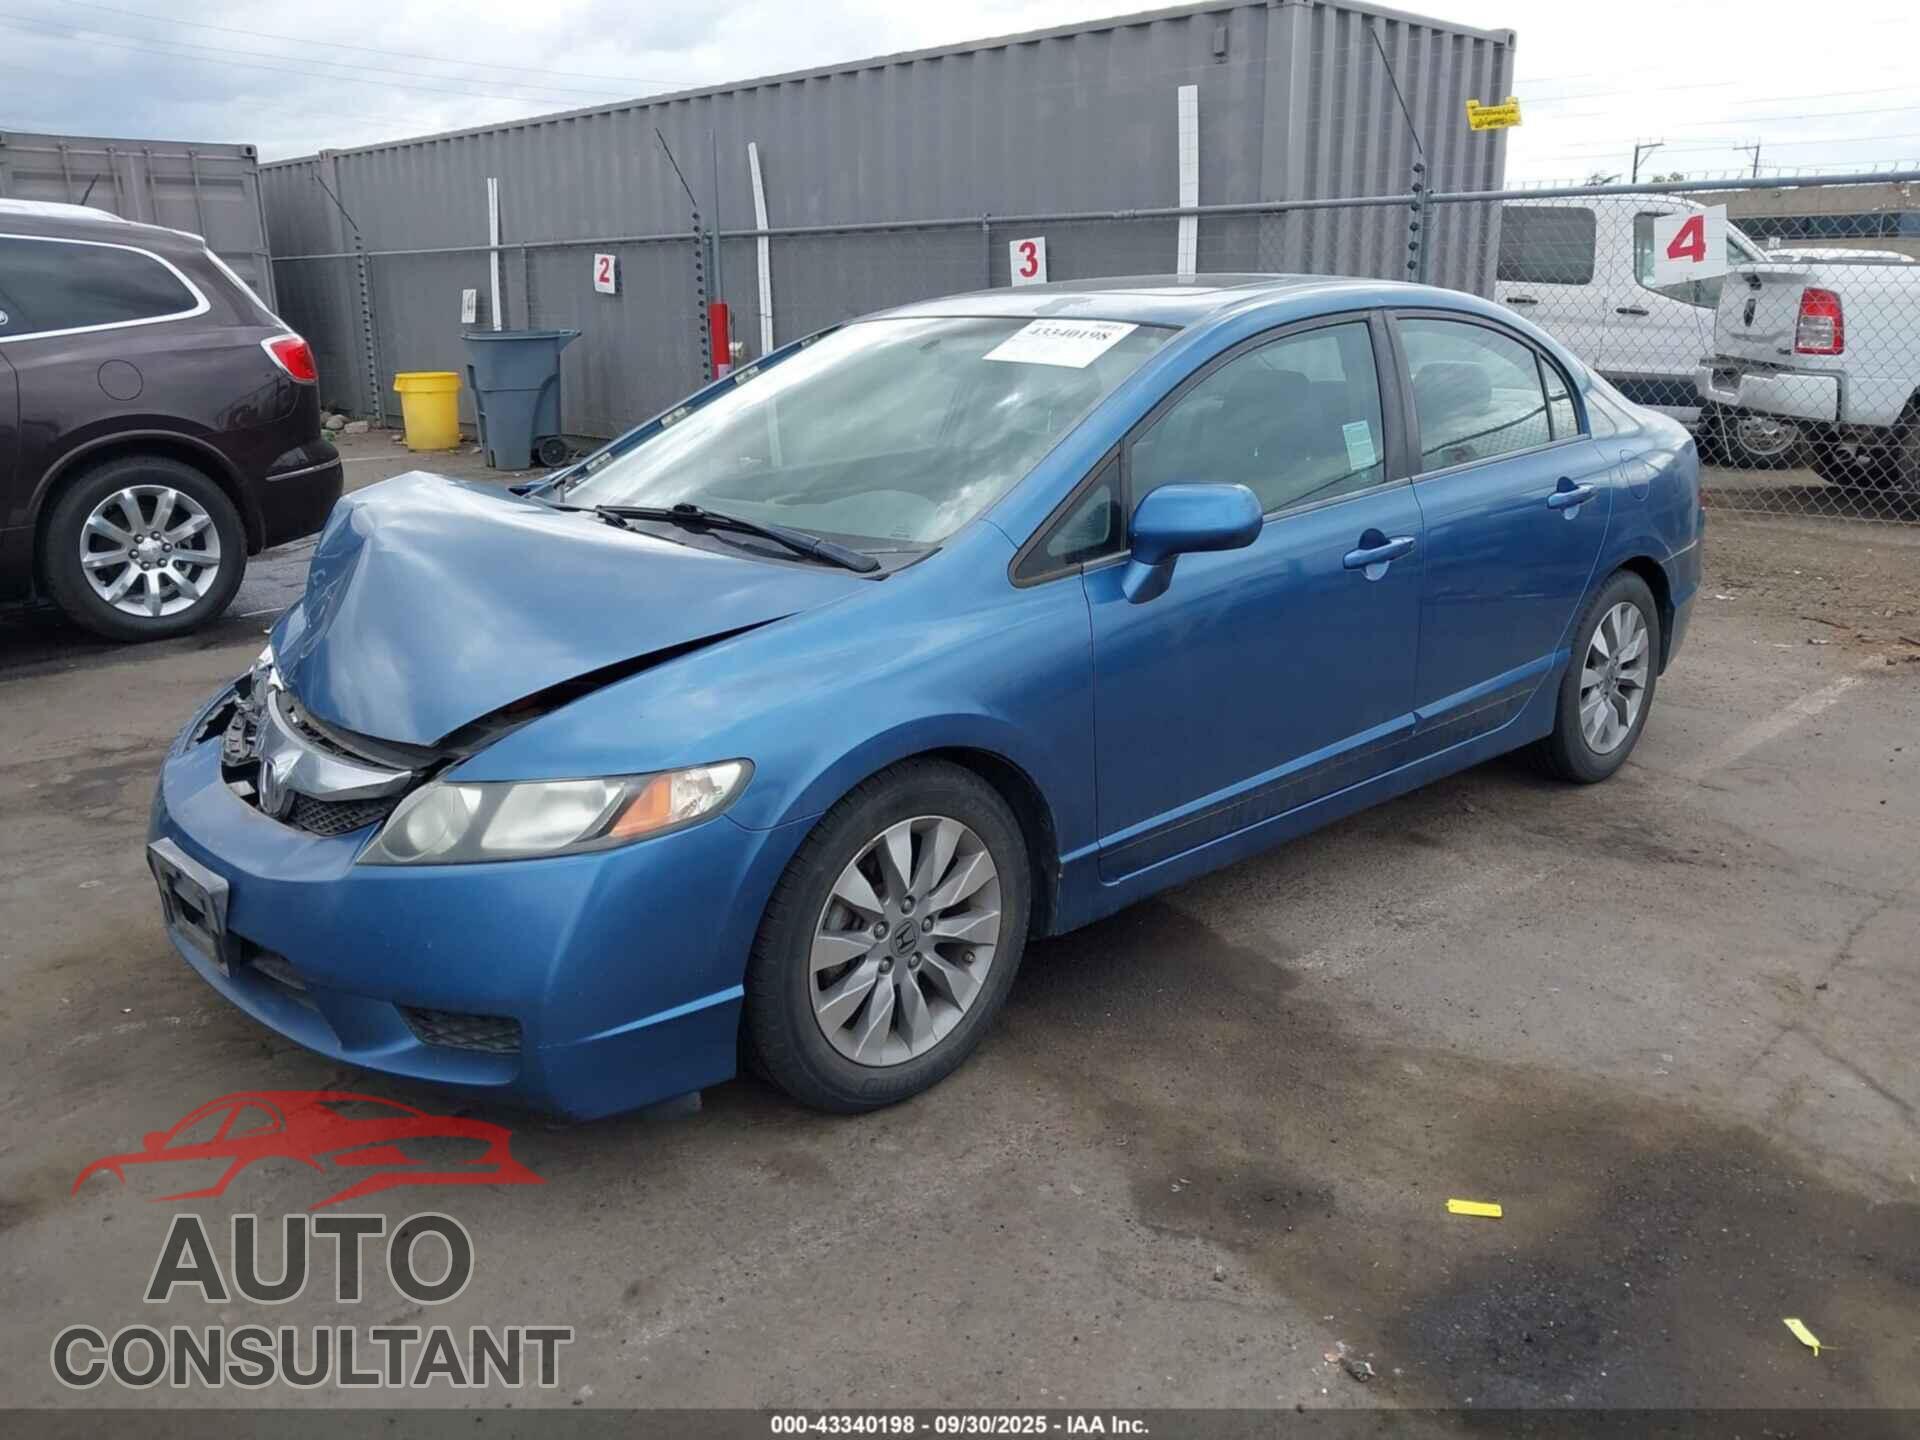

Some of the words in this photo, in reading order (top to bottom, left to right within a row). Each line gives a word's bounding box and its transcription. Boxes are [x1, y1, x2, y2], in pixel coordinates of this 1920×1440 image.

[1667, 214, 1706, 263] 4
[599, 257, 610, 284] 2
[1019, 241, 1038, 278] 3
